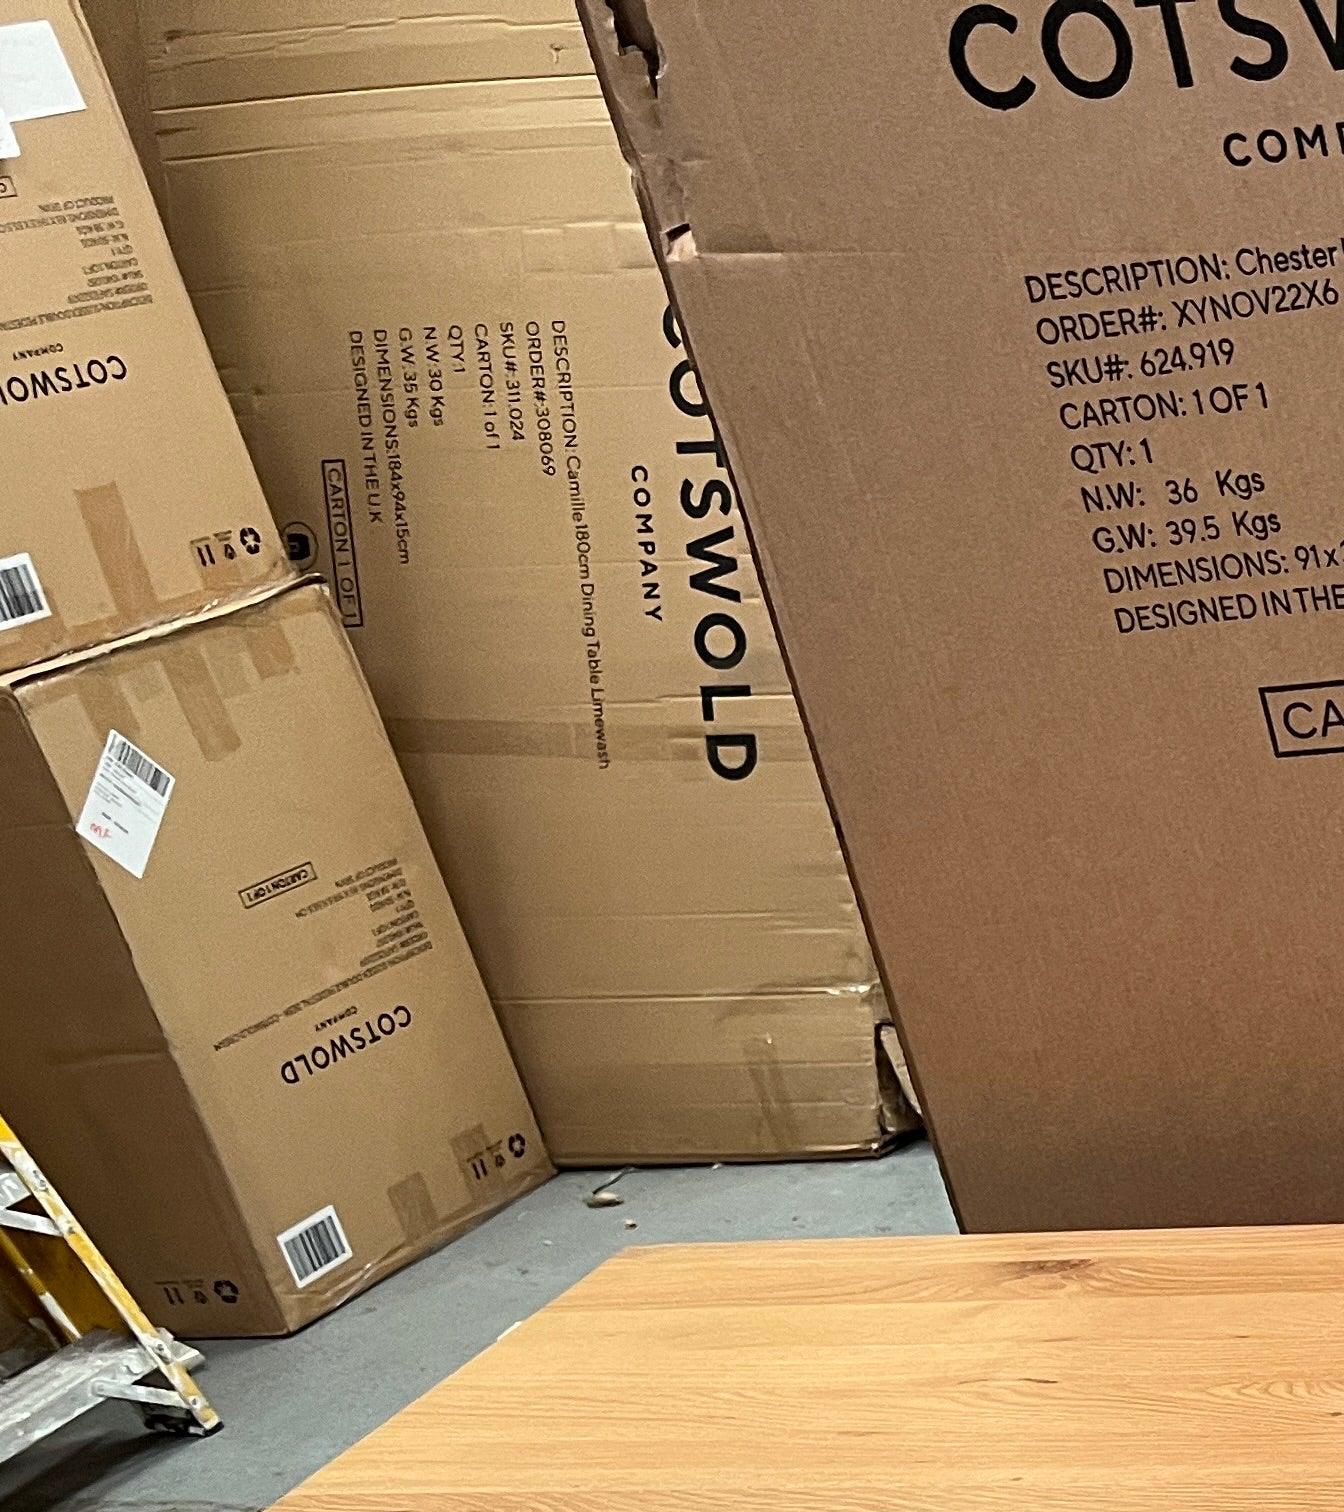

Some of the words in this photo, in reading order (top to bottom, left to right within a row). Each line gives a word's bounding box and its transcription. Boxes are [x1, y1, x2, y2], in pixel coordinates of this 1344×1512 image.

[1024, 253, 1230, 303] DESCRIPTION:
[1236, 244, 1337, 275] Chester
[1036, 305, 1166, 345] ORDER#:
[1171, 278, 1339, 328] XYNOV22X6
[347, 331, 372, 427] DESIGNED
[1047, 354, 1133, 388] SKU#:
[1140, 338, 1234, 376] 624.919
[403, 397, 420, 427] Kgs
[429, 396, 445, 426] Kgs
[484, 422, 500, 439] of
[360, 432, 375, 450] IN
[363, 453, 379, 489] THE
[1081, 481, 1145, 513] N.W:
[1165, 478, 1198, 505] 36
[1215, 469, 1265, 500] Kgs
[328, 468, 350, 552] CARTON
[367, 493, 384, 523] U.K
[631, 466, 662, 621] COMPANY
[1092, 522, 1157, 553] G.W:
[1166, 516, 1220, 545] 39.5
[1232, 511, 1281, 540] Kgs
[1104, 549, 1289, 593] DIMENSIONS:
[581, 584, 596, 637] Dining
[1114, 594, 1257, 633] DESIGNED
[1261, 589, 1292, 616] IN
[587, 640, 603, 684] Table
[591, 688, 610, 769] Limewash
[281, 1005, 412, 1084] COTSWOLD
